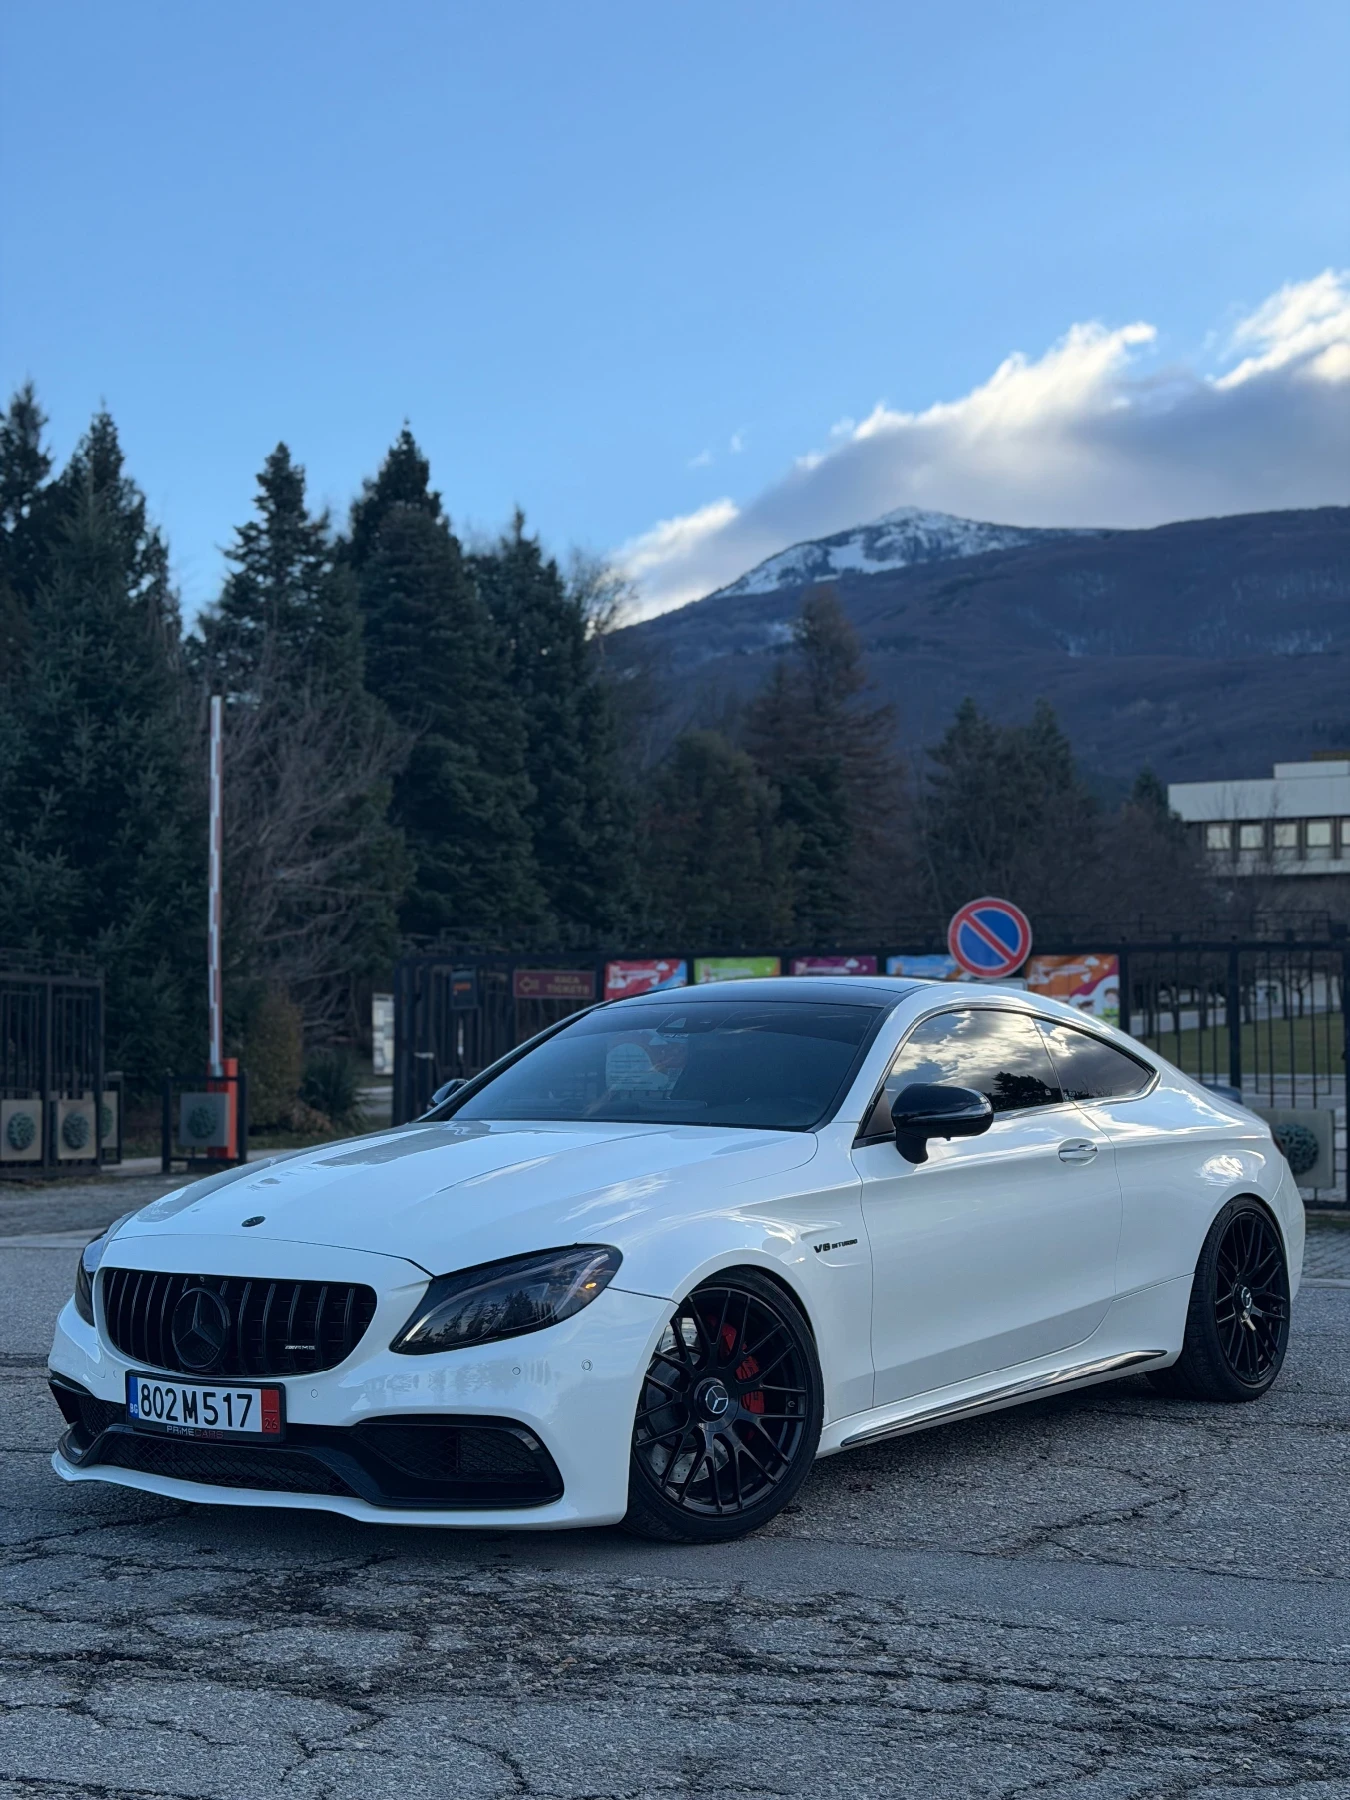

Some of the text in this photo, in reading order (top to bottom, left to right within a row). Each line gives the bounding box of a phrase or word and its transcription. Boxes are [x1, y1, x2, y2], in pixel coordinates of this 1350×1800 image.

[130, 1403, 138, 1413] BG
[141, 1384, 252, 1427] 802M517
[265, 1418, 278, 1429] 26
